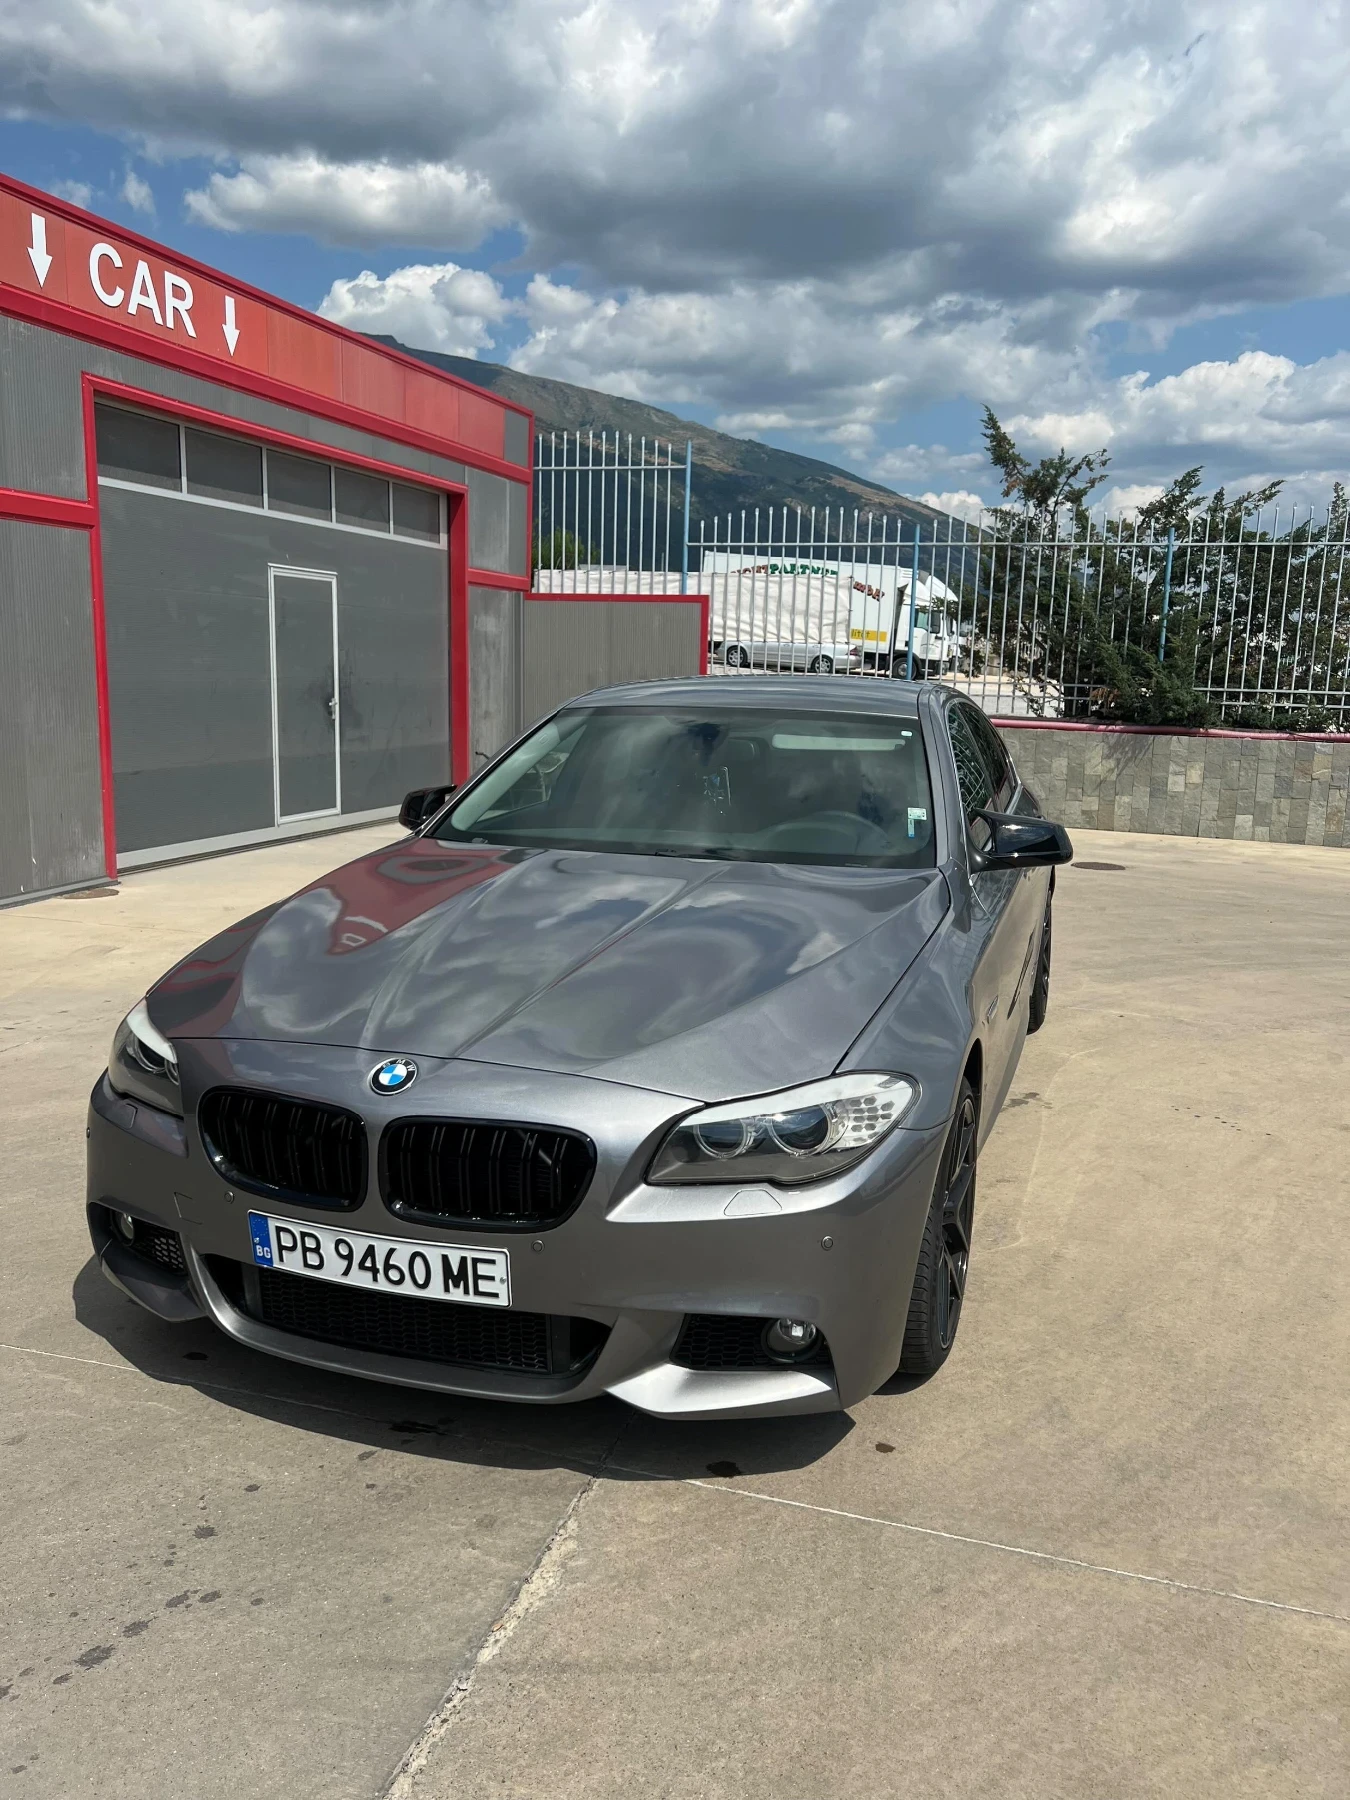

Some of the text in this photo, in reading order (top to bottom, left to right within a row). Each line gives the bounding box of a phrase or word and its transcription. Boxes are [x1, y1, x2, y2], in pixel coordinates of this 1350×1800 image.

[89, 242, 197, 338] CAR
[381, 1058, 416, 1072] BMW
[255, 1245, 271, 1259] BG
[274, 1224, 500, 1298] PB 9460 ME
